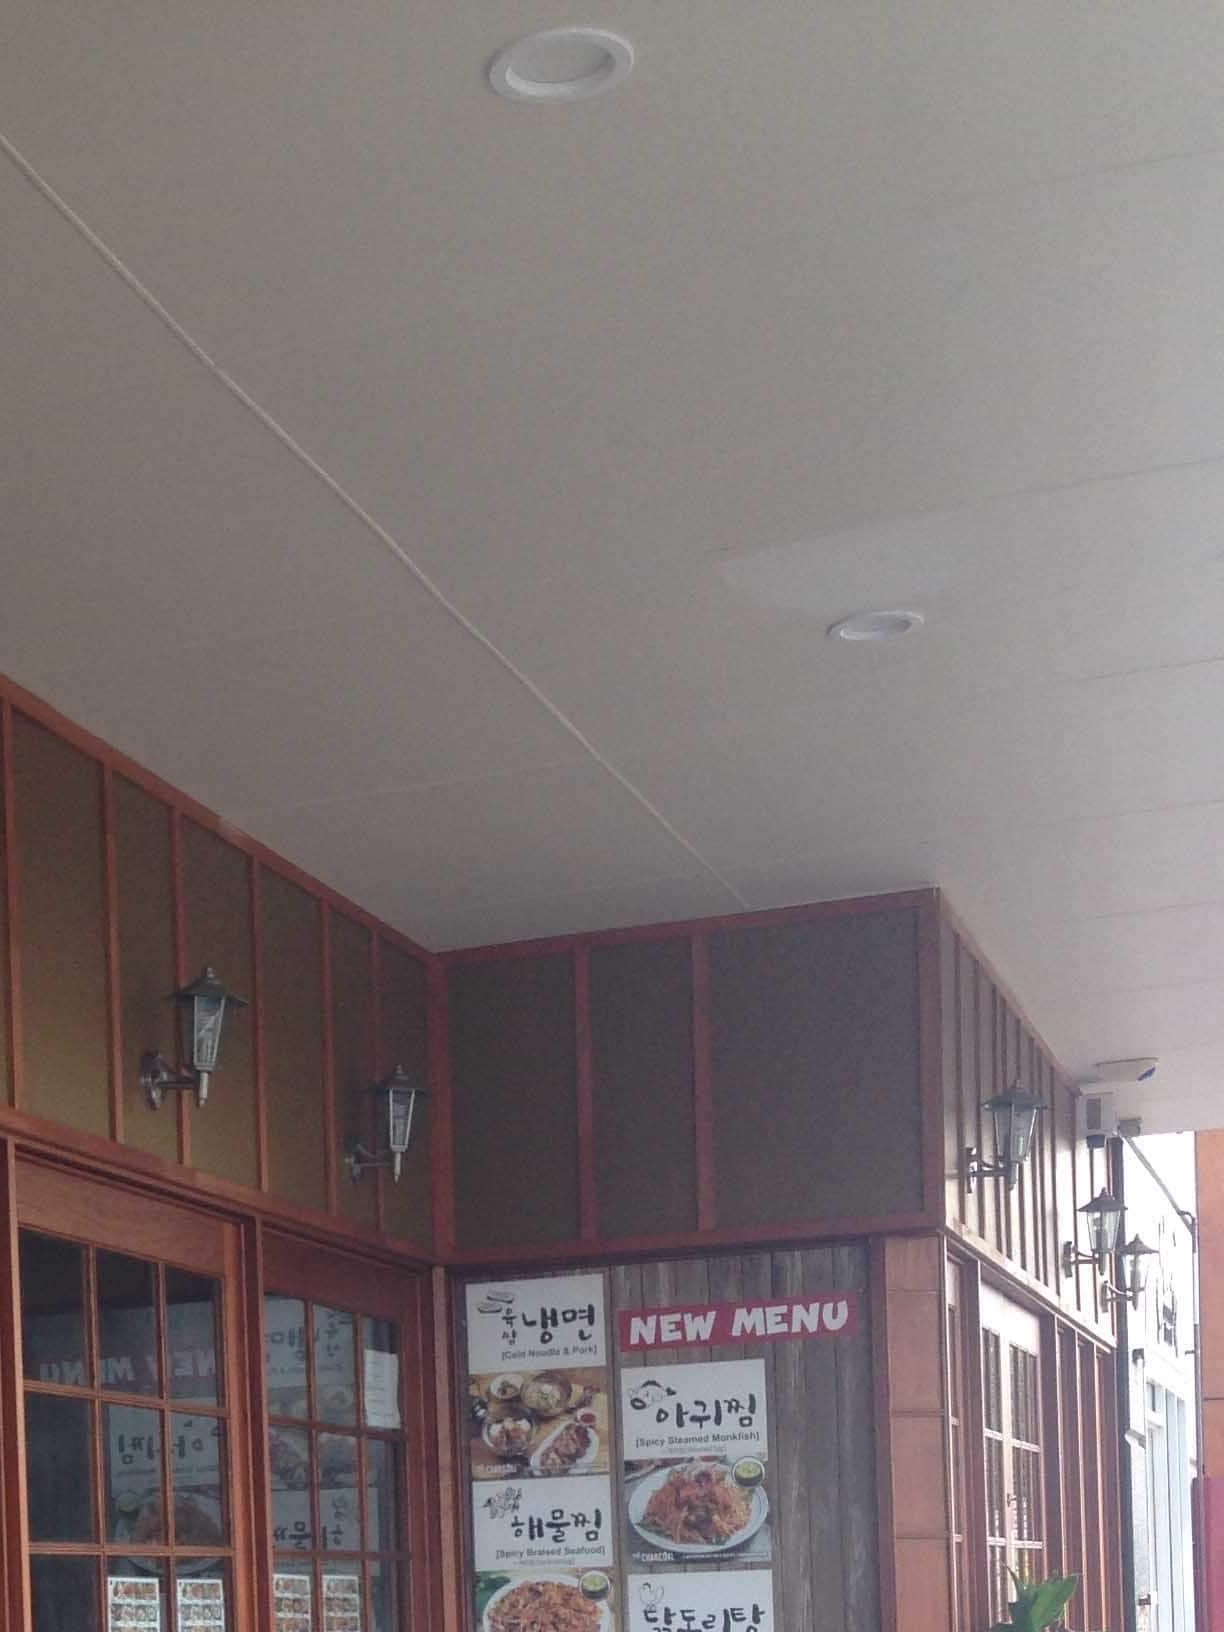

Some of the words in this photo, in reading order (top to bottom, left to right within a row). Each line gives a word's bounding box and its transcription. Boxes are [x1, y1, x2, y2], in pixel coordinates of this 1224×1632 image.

[522, 1303, 595, 1344] 냉면
[630, 1311, 716, 1345] NEW
[731, 1300, 849, 1337] MENU
[656, 1393, 756, 1429] 아귀찜
[511, 1508, 602, 1543] 해물찜
